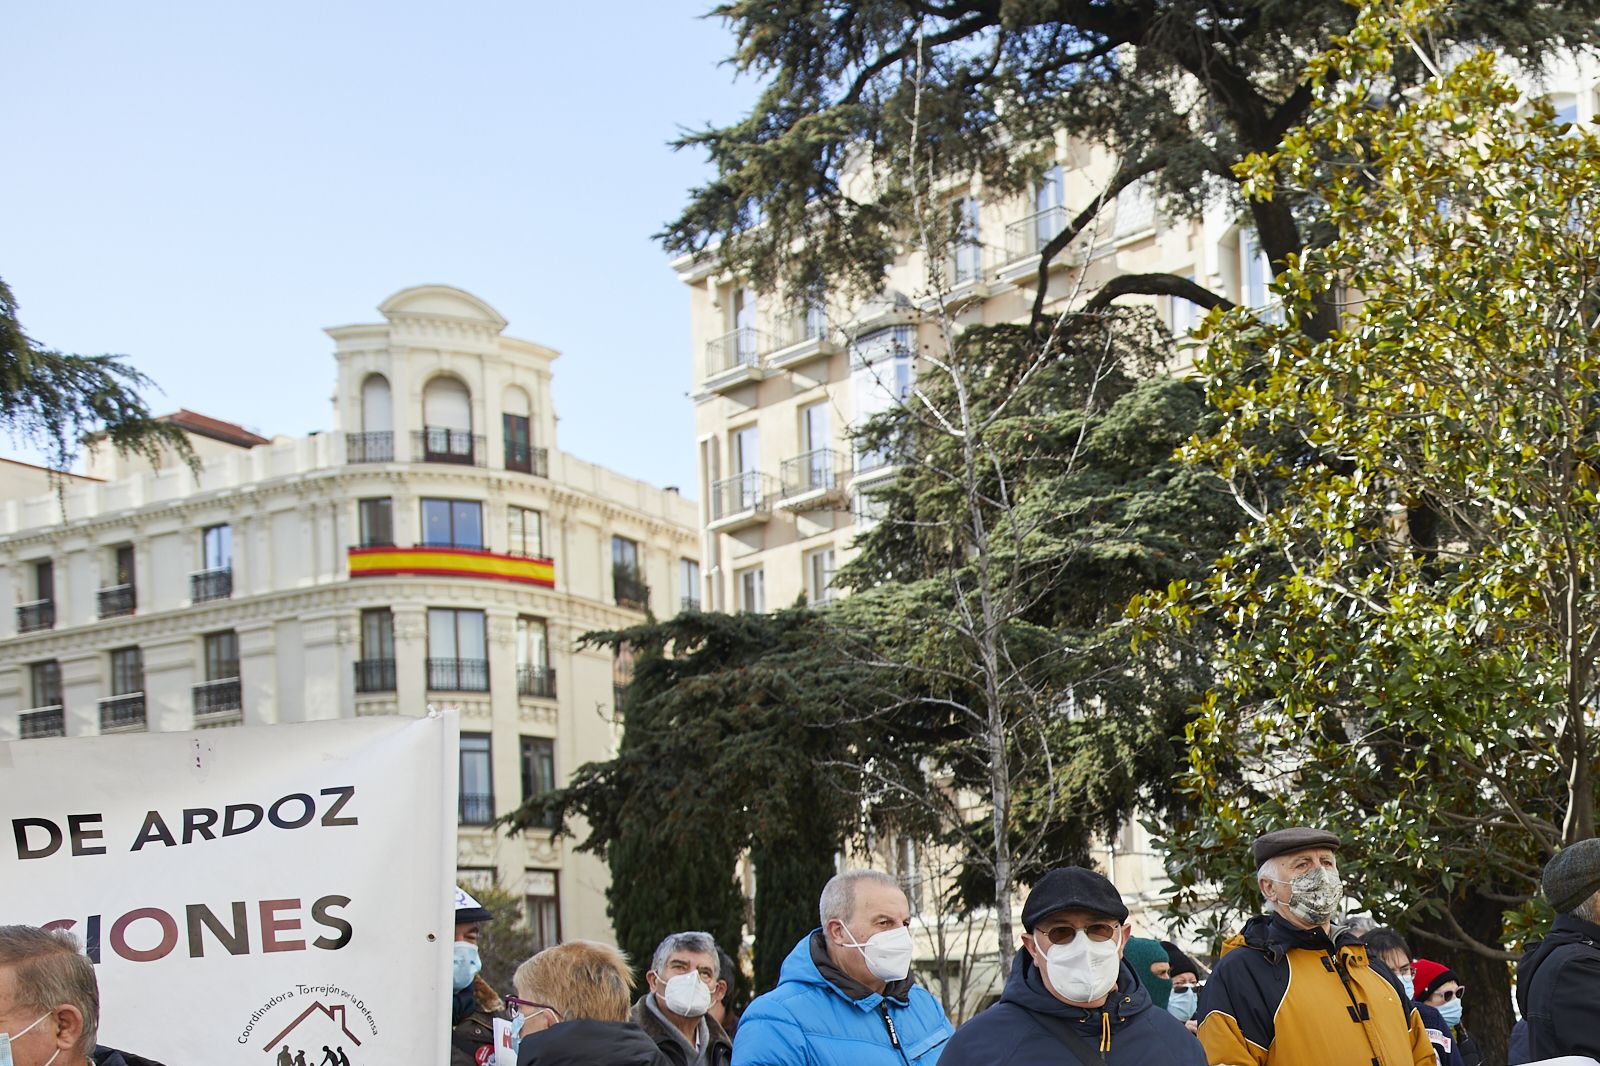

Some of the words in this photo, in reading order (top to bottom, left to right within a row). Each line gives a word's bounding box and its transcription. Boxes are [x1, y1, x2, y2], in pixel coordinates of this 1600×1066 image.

[11, 813, 107, 860] DE
[130, 786, 358, 851] ARDOZ
[40, 895, 353, 965] IONES
[238, 991, 294, 1044] Coordinadora
[296, 984, 340, 997] Torrejón
[357, 1000, 378, 1036] Defensa
